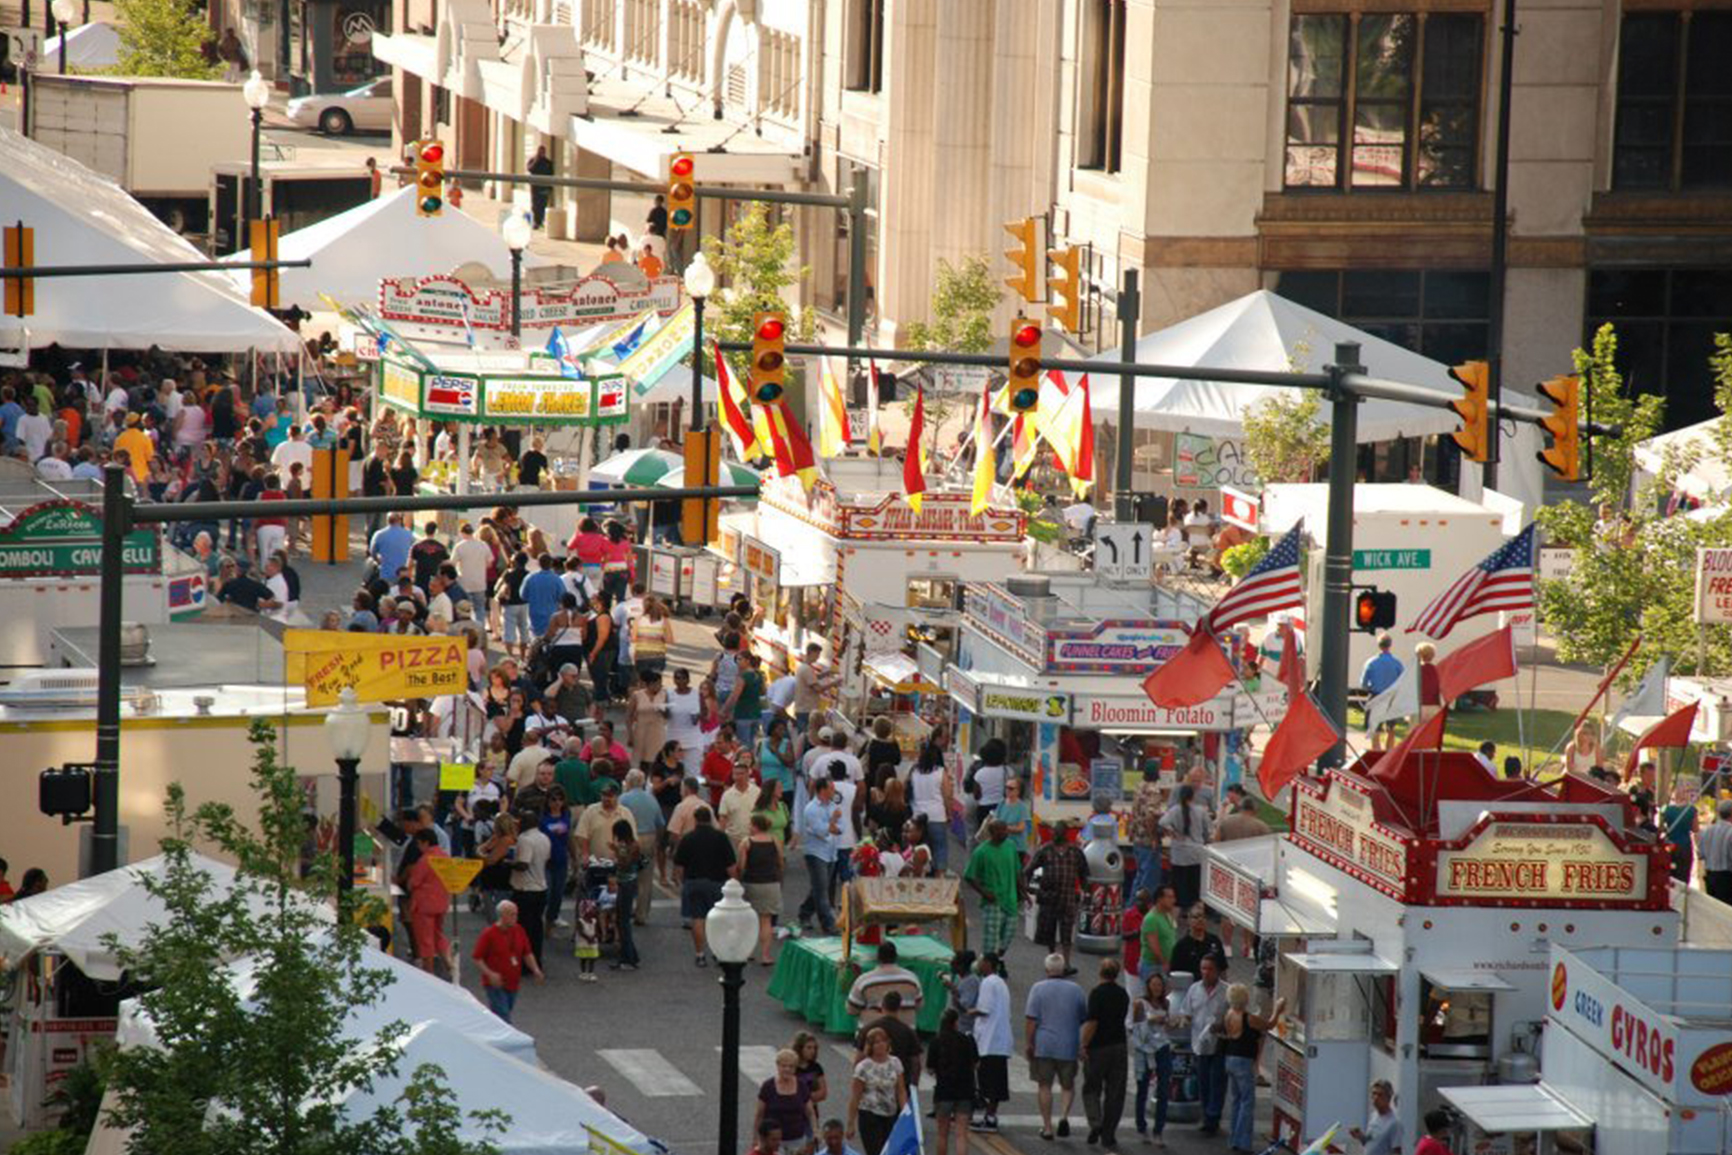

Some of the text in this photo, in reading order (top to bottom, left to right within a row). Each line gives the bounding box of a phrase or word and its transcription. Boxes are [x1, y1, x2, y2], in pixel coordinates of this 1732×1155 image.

[539, 307, 568, 319] CHEESE
[430, 376, 474, 391] PEPSI
[1199, 467, 1255, 486] DOLC
[71, 547, 152, 565] CAVELLI
[1364, 551, 1392, 567] WICK
[1126, 566, 1148, 576] ONLY
[380, 644, 462, 671] PIZZA
[1060, 643, 1101, 658] FUNNEL
[1101, 644, 1135, 659] CAKES
[308, 653, 345, 688] FRESH
[408, 672, 457, 685] The Best
[1091, 701, 1156, 723] Bloomin
[1165, 706, 1214, 724] Potato
[1300, 802, 1401, 877] FRENCH FRIES
[1450, 859, 1634, 894] FRENCH FRIES
[1575, 989, 1604, 1027] GREEK
[1611, 1003, 1674, 1084] GYROS
